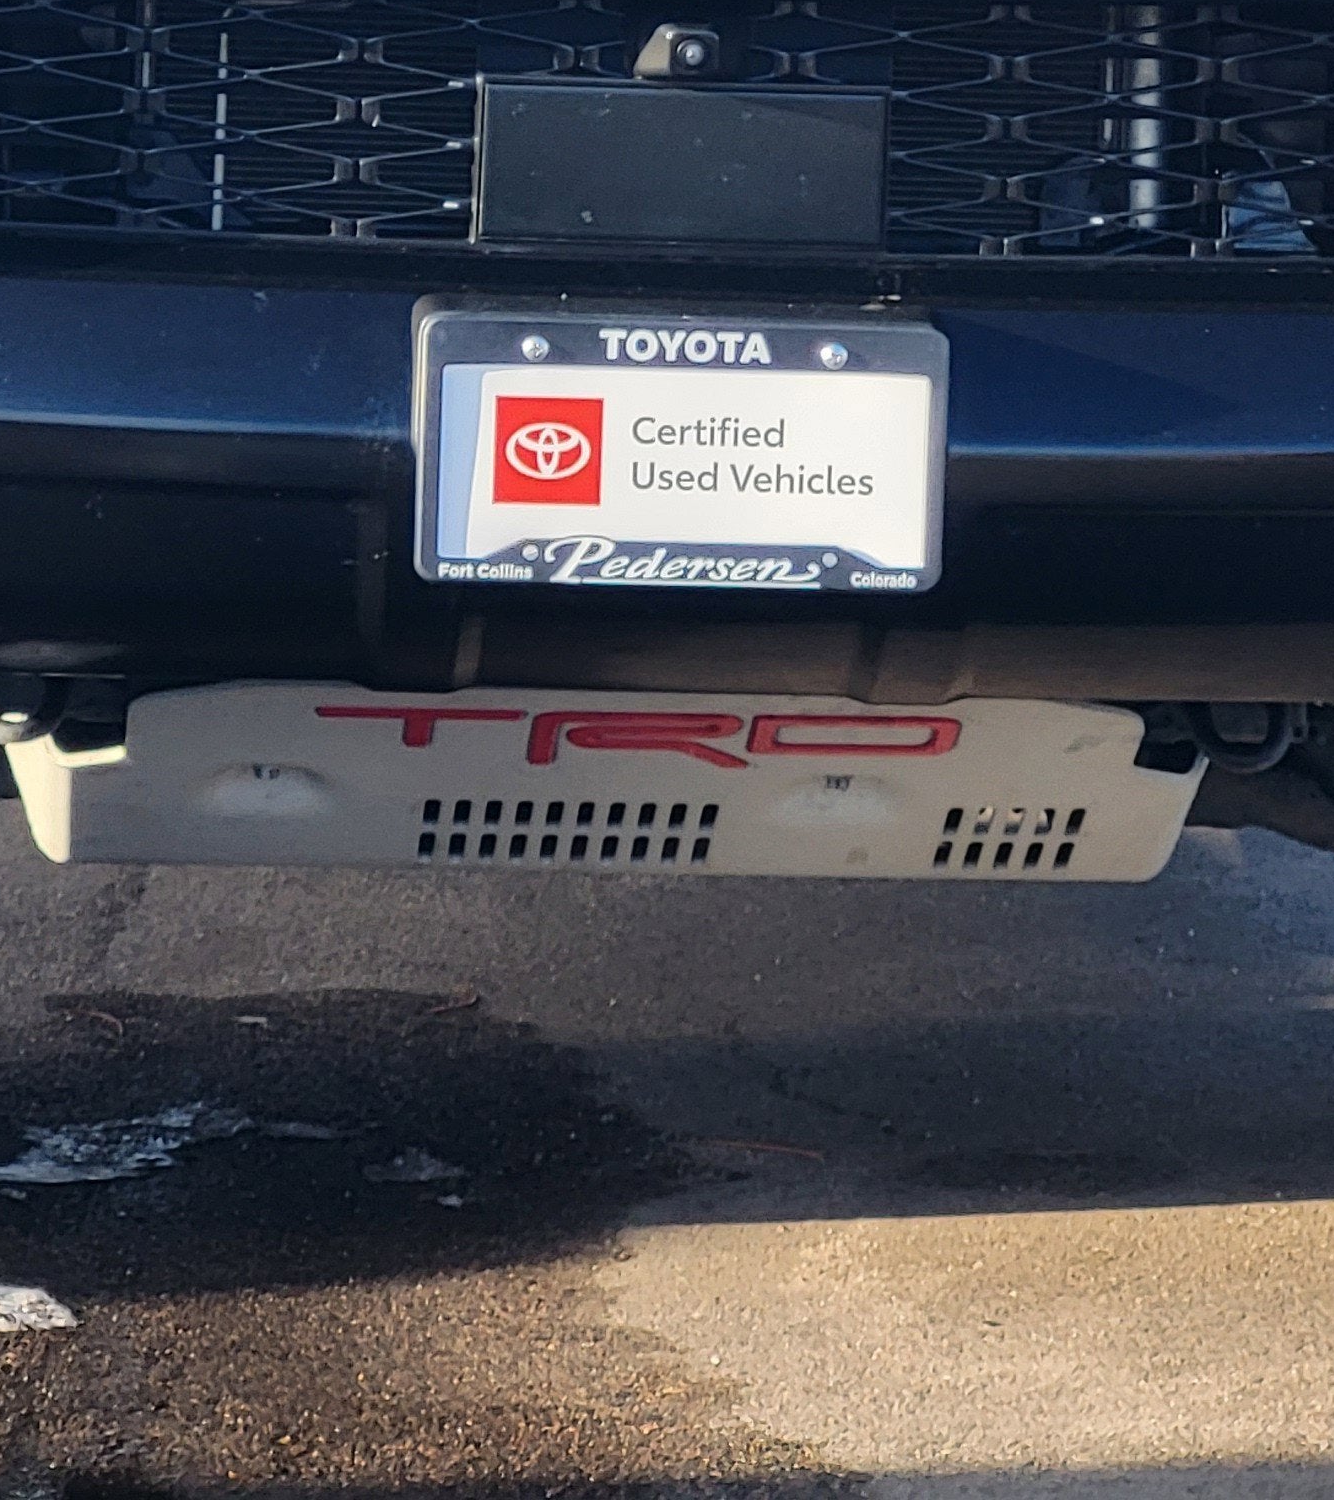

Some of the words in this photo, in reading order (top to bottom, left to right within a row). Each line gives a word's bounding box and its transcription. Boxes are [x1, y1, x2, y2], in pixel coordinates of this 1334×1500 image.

[598, 328, 772, 366] TOYOTA
[631, 417, 786, 448] Certified
[631, 462, 718, 492] Used
[729, 463, 874, 496] Vehicles
[437, 562, 475, 579] Fort
[476, 562, 534, 580] Collins
[544, 535, 822, 589] Pedersen
[850, 570, 919, 589] Colorado
[314, 705, 963, 769] TRD
